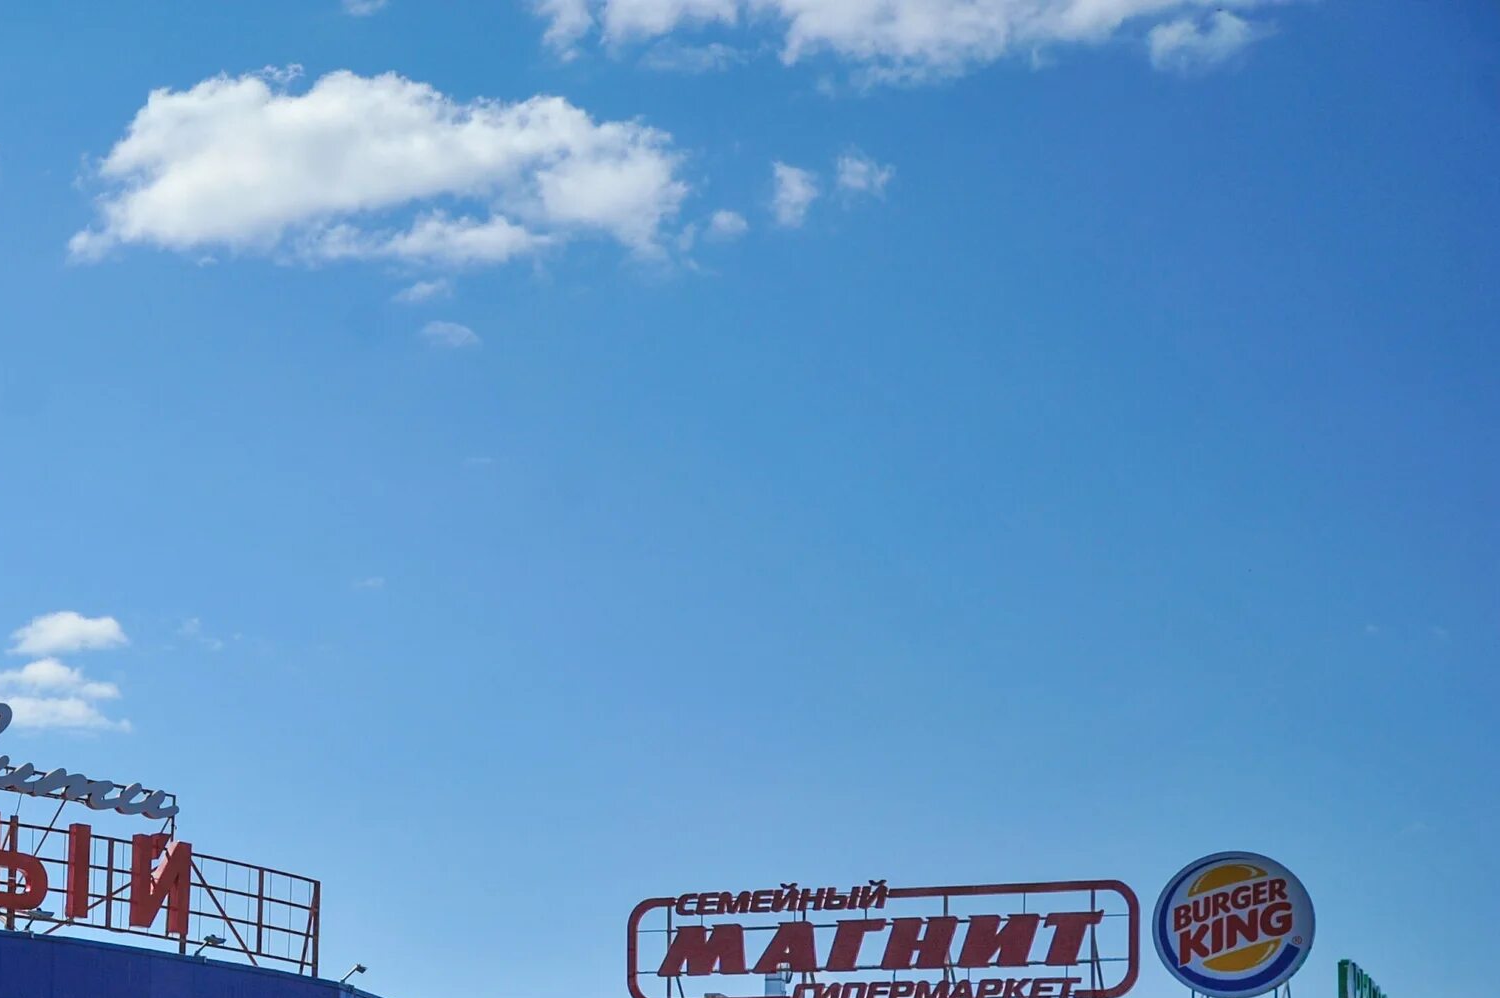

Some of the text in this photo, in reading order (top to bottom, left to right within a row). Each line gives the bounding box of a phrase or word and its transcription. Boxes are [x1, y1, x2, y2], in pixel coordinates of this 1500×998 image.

[675, 879, 890, 916] СЕМЕЙНЫЙ
[1174, 879, 1288, 932] BURGER
[657, 910, 1104, 977] МАГНИТ
[1179, 901, 1293, 967] KING
